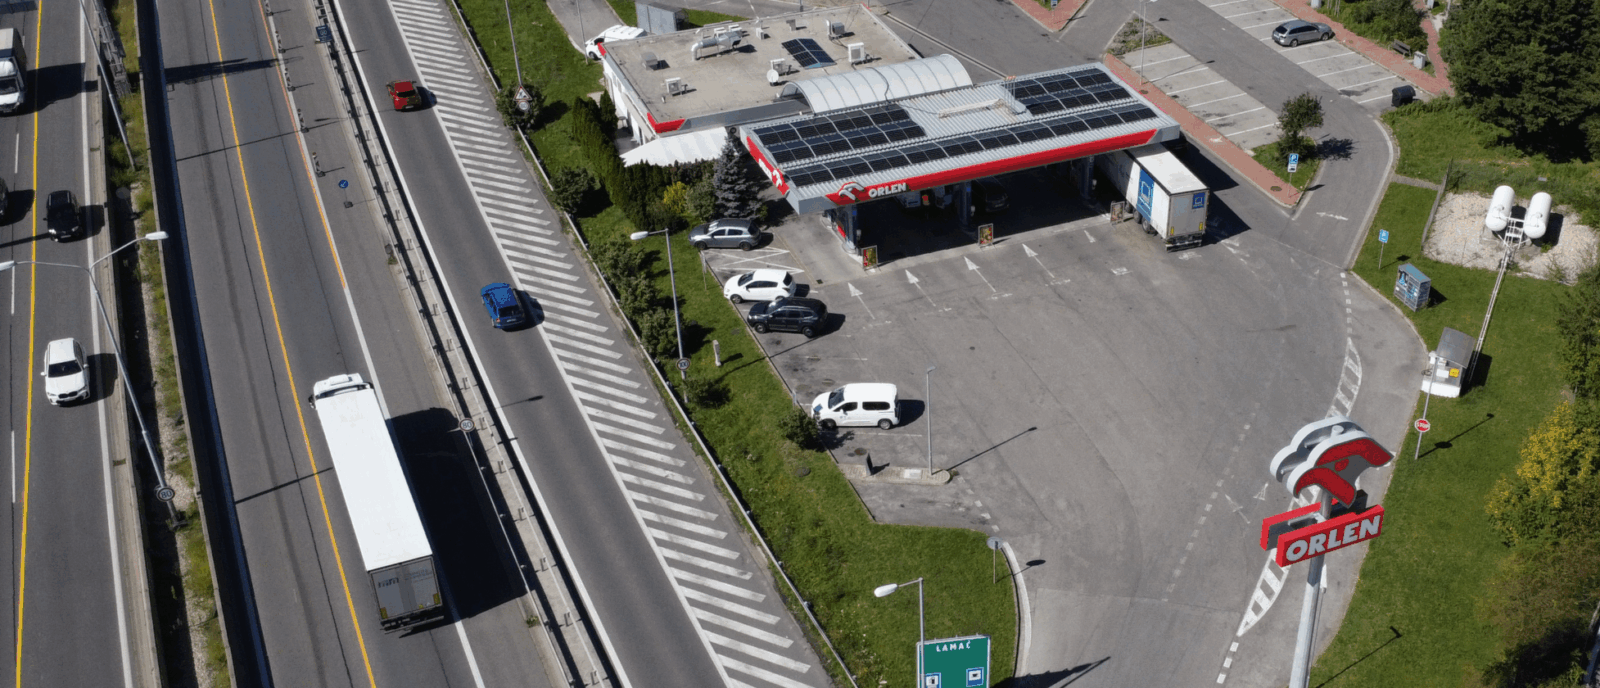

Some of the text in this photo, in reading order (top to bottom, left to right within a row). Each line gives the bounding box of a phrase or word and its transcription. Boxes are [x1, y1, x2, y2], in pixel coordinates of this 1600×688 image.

[868, 182, 907, 198] ORLEN
[462, 421, 472, 429] 80
[160, 491, 172, 499] 80
[1286, 515, 1381, 562] ORLEN
